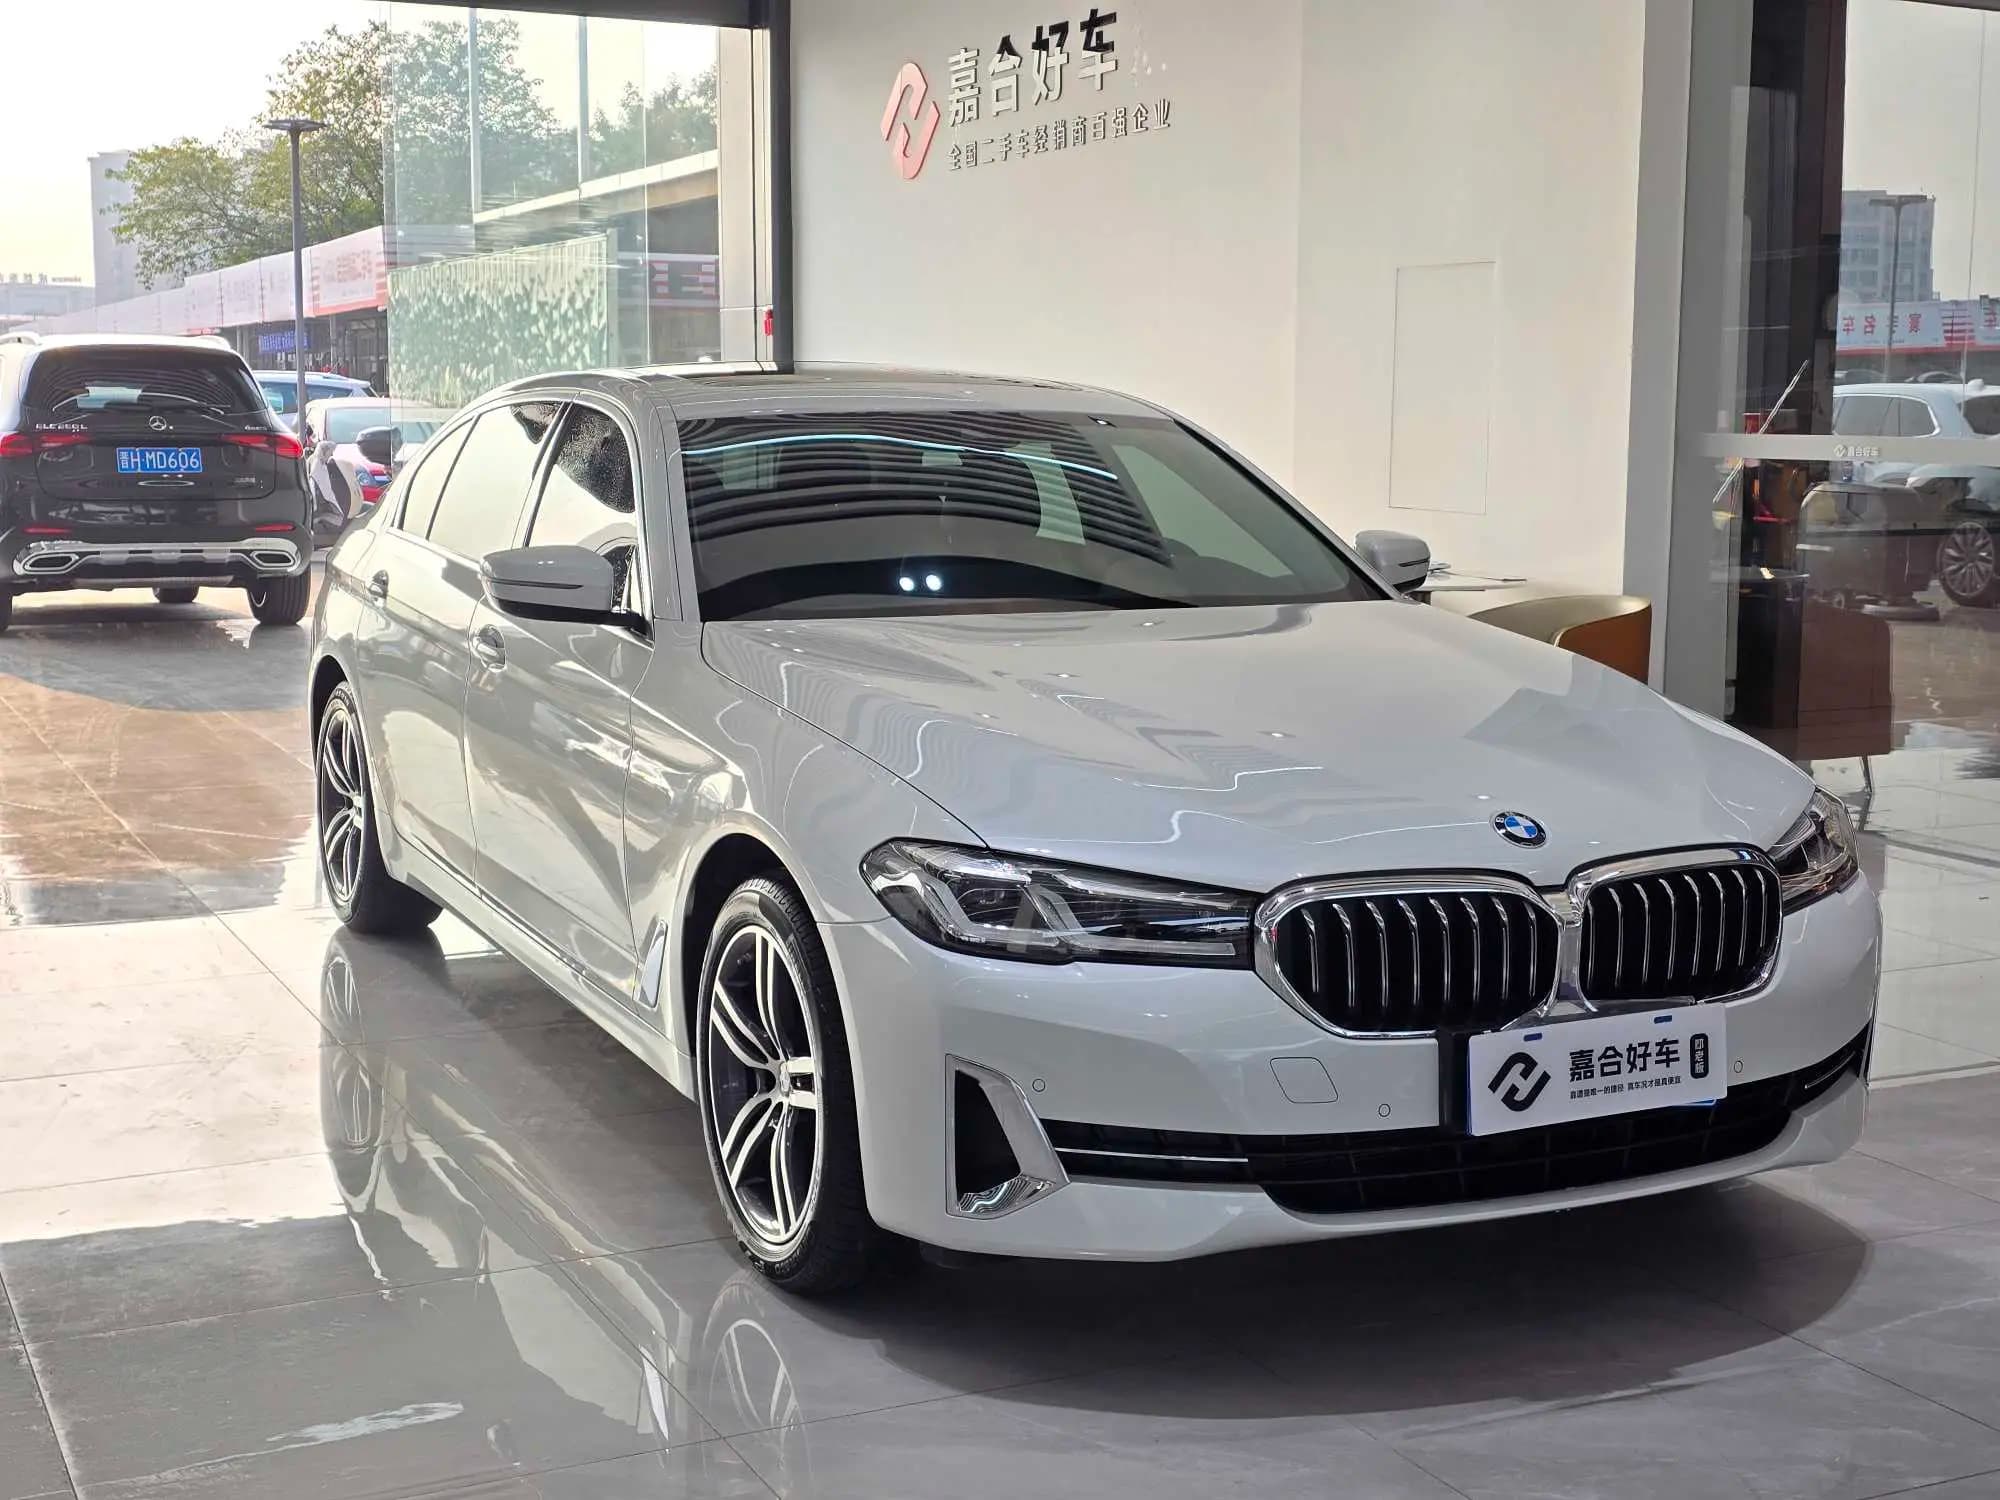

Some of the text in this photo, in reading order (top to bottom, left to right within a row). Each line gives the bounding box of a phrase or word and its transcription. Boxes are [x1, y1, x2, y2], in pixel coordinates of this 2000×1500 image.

[949, 8, 1118, 126] 嘉合好车
[949, 99, 1171, 171] 全国二手车经销商百强企业
[1569, 1038, 1680, 1082] 嘉合好车
